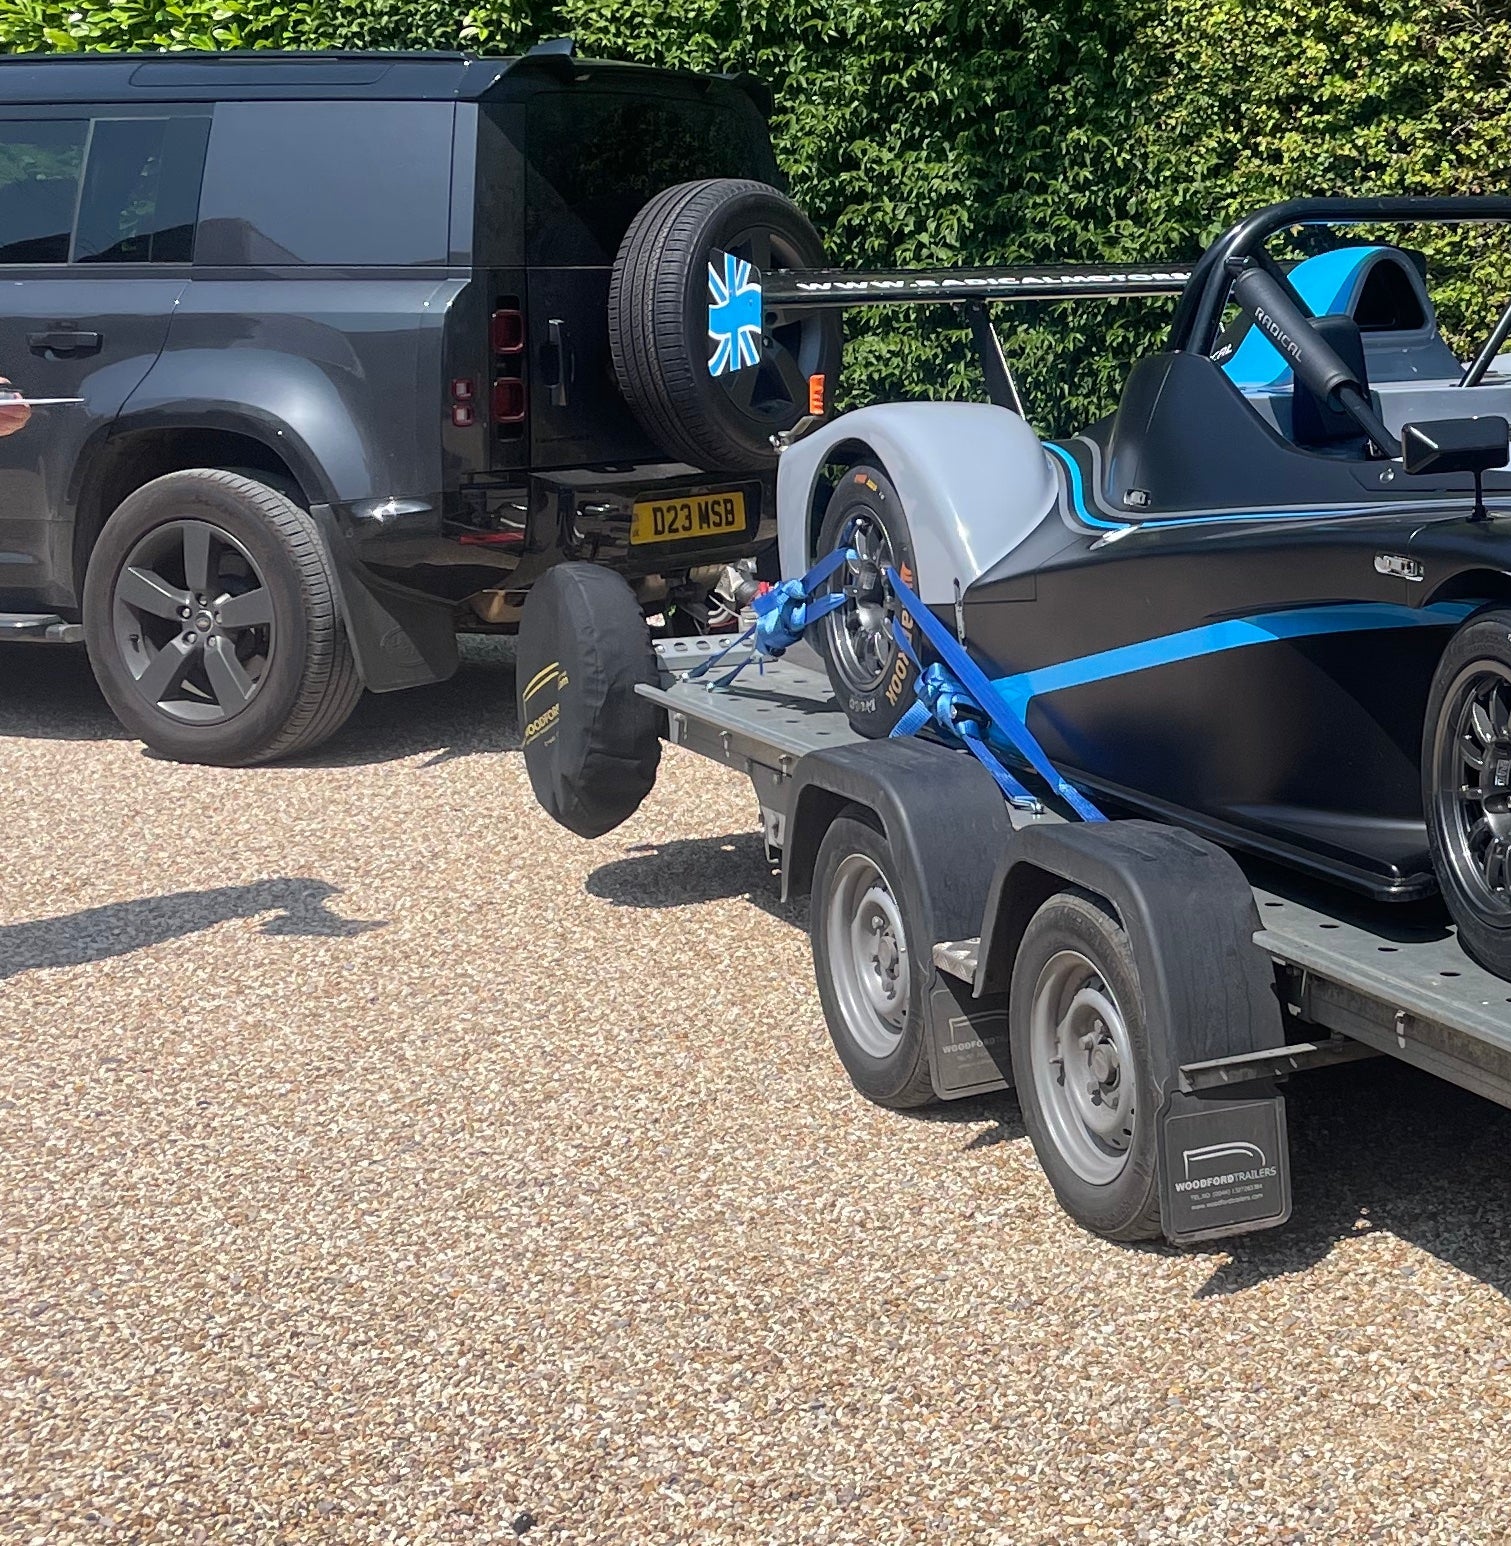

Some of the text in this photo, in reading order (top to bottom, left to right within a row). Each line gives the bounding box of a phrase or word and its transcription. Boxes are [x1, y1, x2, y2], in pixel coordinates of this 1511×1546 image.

[796, 272, 1192, 291] WWW.RADICALMOTORS
[1254, 306, 1302, 363] RADICAL
[652, 498, 735, 536] D23 MSB
[1175, 1166, 1277, 1192] WOODFORDTRAILERS
